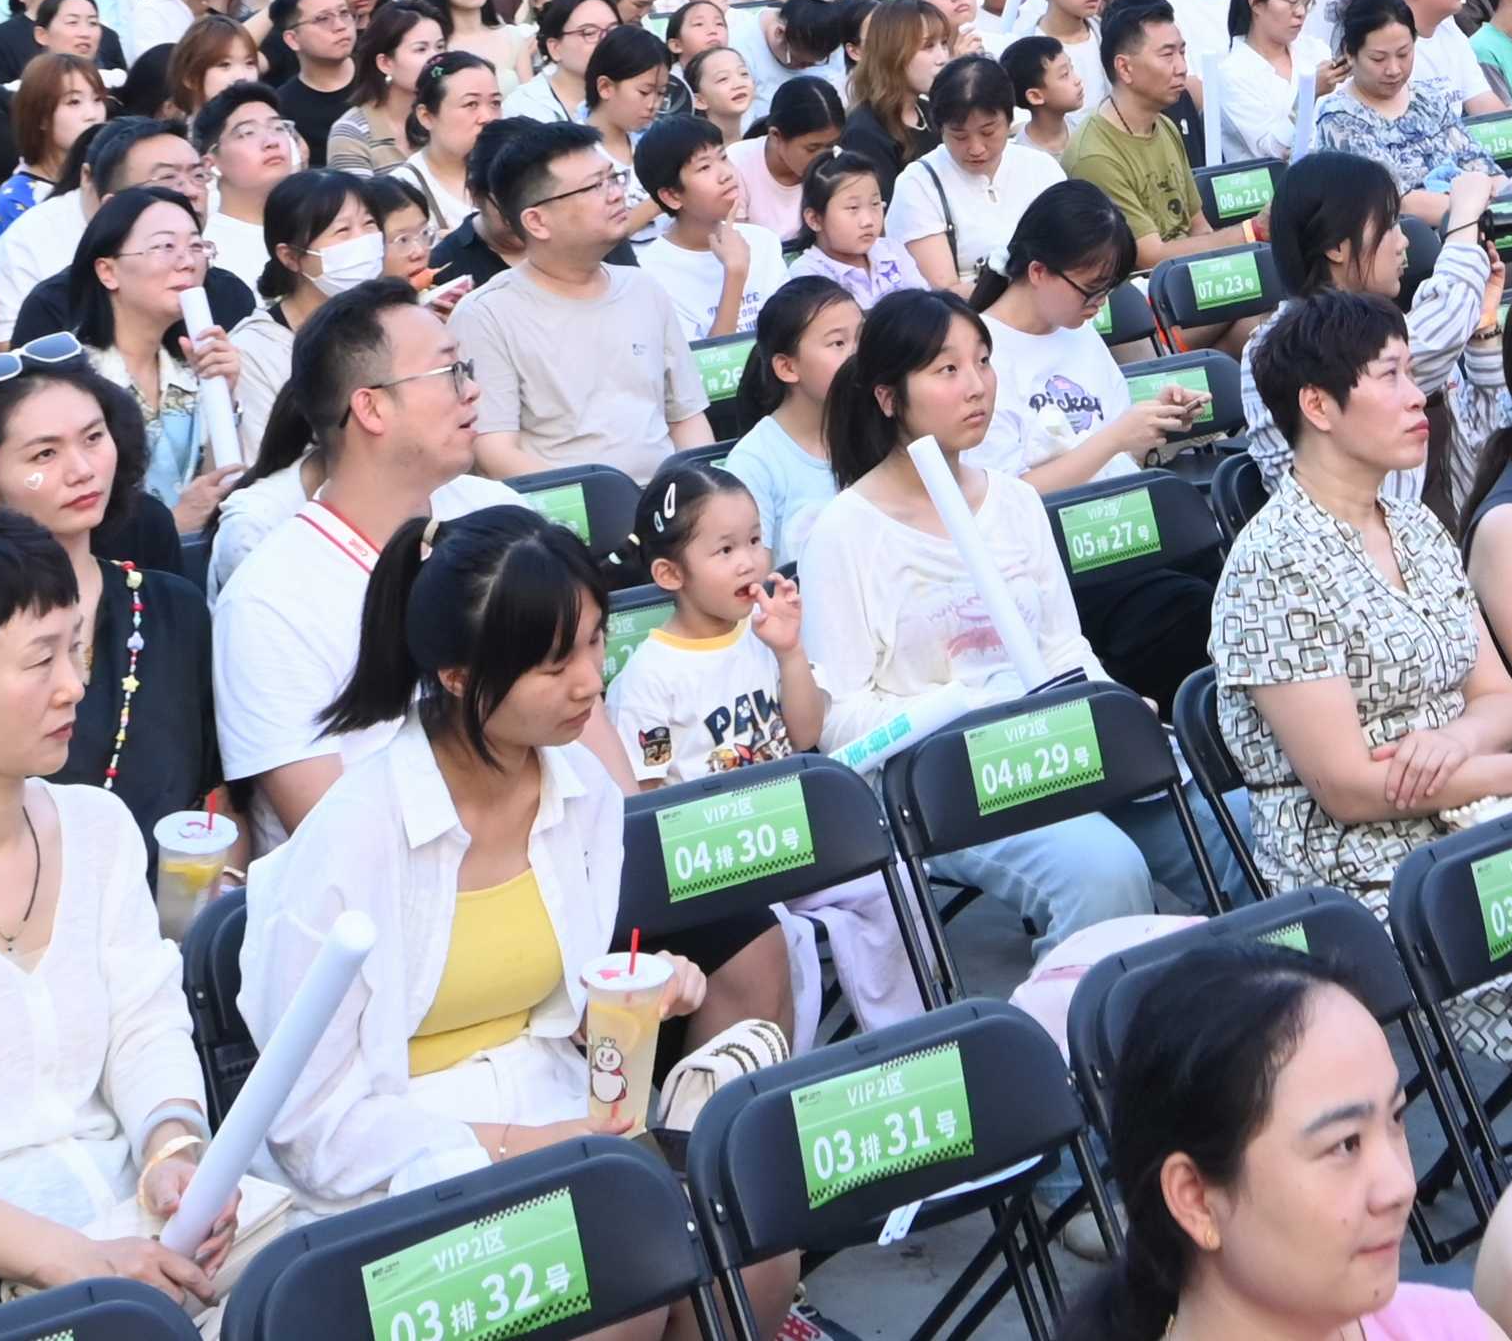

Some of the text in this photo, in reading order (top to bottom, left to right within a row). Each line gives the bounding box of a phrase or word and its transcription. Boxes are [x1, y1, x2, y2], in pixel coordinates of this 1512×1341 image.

[1072, 521, 1150, 560] 05排27号
[1003, 719, 1049, 745] VIP2区
[981, 743, 1090, 796] 04排29号
[702, 796, 756, 826] VIP2区
[674, 823, 800, 881] 04排30号
[845, 1071, 906, 1109] VIP2区
[812, 1105, 958, 1181] 03排31号
[431, 1226, 507, 1274] VIP2区
[388, 1260, 571, 1341] 03排32号
